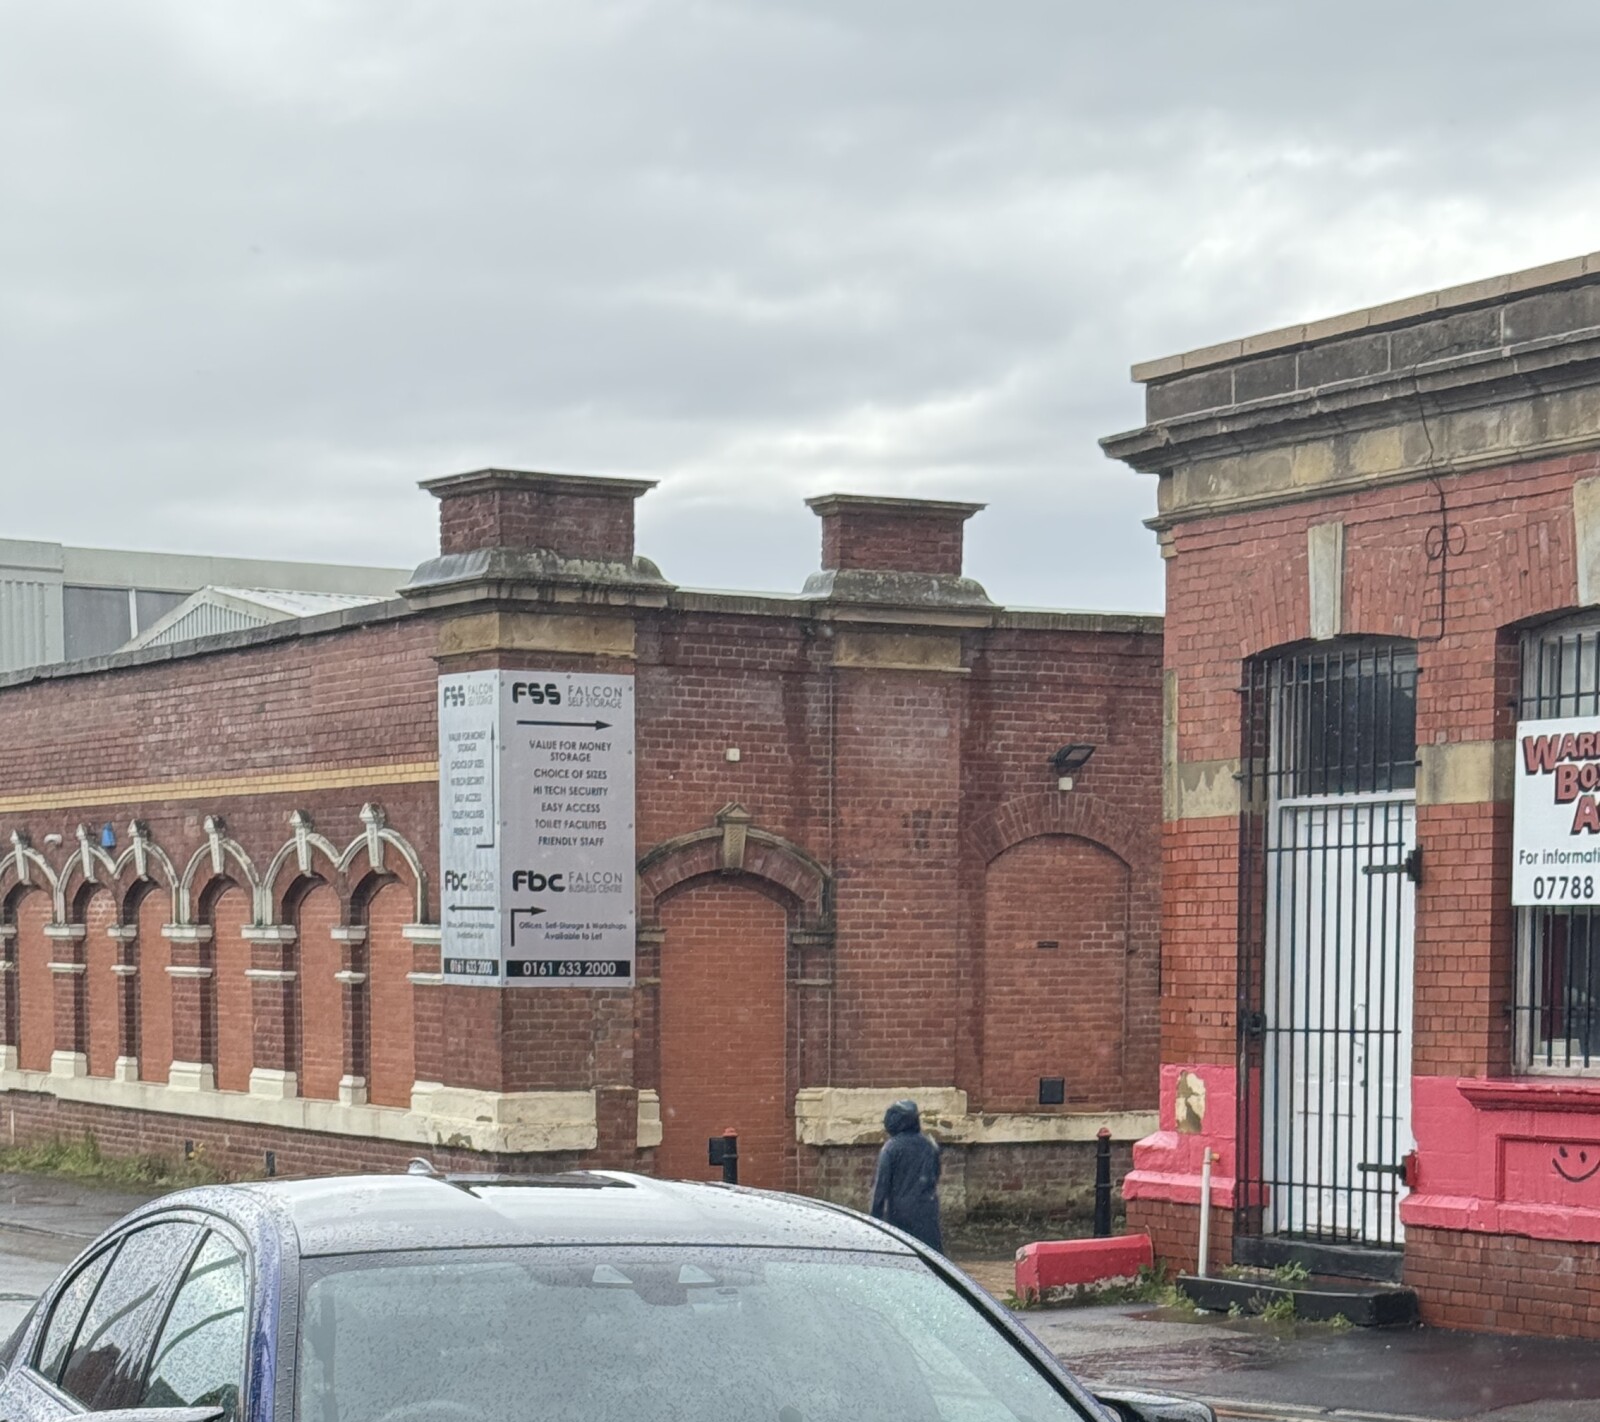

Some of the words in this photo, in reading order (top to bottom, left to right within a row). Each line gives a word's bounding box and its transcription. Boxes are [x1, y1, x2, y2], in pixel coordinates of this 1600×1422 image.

[443, 684, 466, 708] FSS
[512, 682, 561, 705] FSS
[568, 685, 623, 698] FALCON
[568, 697, 585, 707] SELF
[586, 698, 623, 709] STORAGE
[529, 740, 557, 750] VALUE
[560, 741, 577, 751] FOR
[579, 741, 612, 752] MONEY
[550, 752, 592, 762] STORAGE
[1522, 732, 1600, 775] WAR
[533, 768, 570, 779] CHOICE
[571, 770, 583, 779] OF
[586, 770, 608, 780] SIZES
[1554, 763, 1600, 804] BO
[533, 785, 543, 795] HI
[545, 786, 567, 796] TECH
[568, 786, 609, 797] SECURITY
[541, 802, 564, 812] EASY
[565, 803, 601, 813] ACCESS
[535, 819, 562, 830] TOILET
[564, 820, 607, 830] FACILITIES
[538, 836, 578, 846] FRIENDLY
[580, 837, 605, 846] STAFF
[1519, 849, 1539, 865] For
[445, 870, 468, 892] Fbc
[512, 870, 566, 892] Fbc
[568, 871, 623, 884] FALCON
[1533, 876, 1594, 900] 07788
[544, 932, 580, 941] Available
[582, 932, 590, 941] to
[591, 932, 603, 941] Let
[523, 962, 554, 976] 0161
[558, 962, 581, 976] 633
[584, 962, 617, 976] 2000
